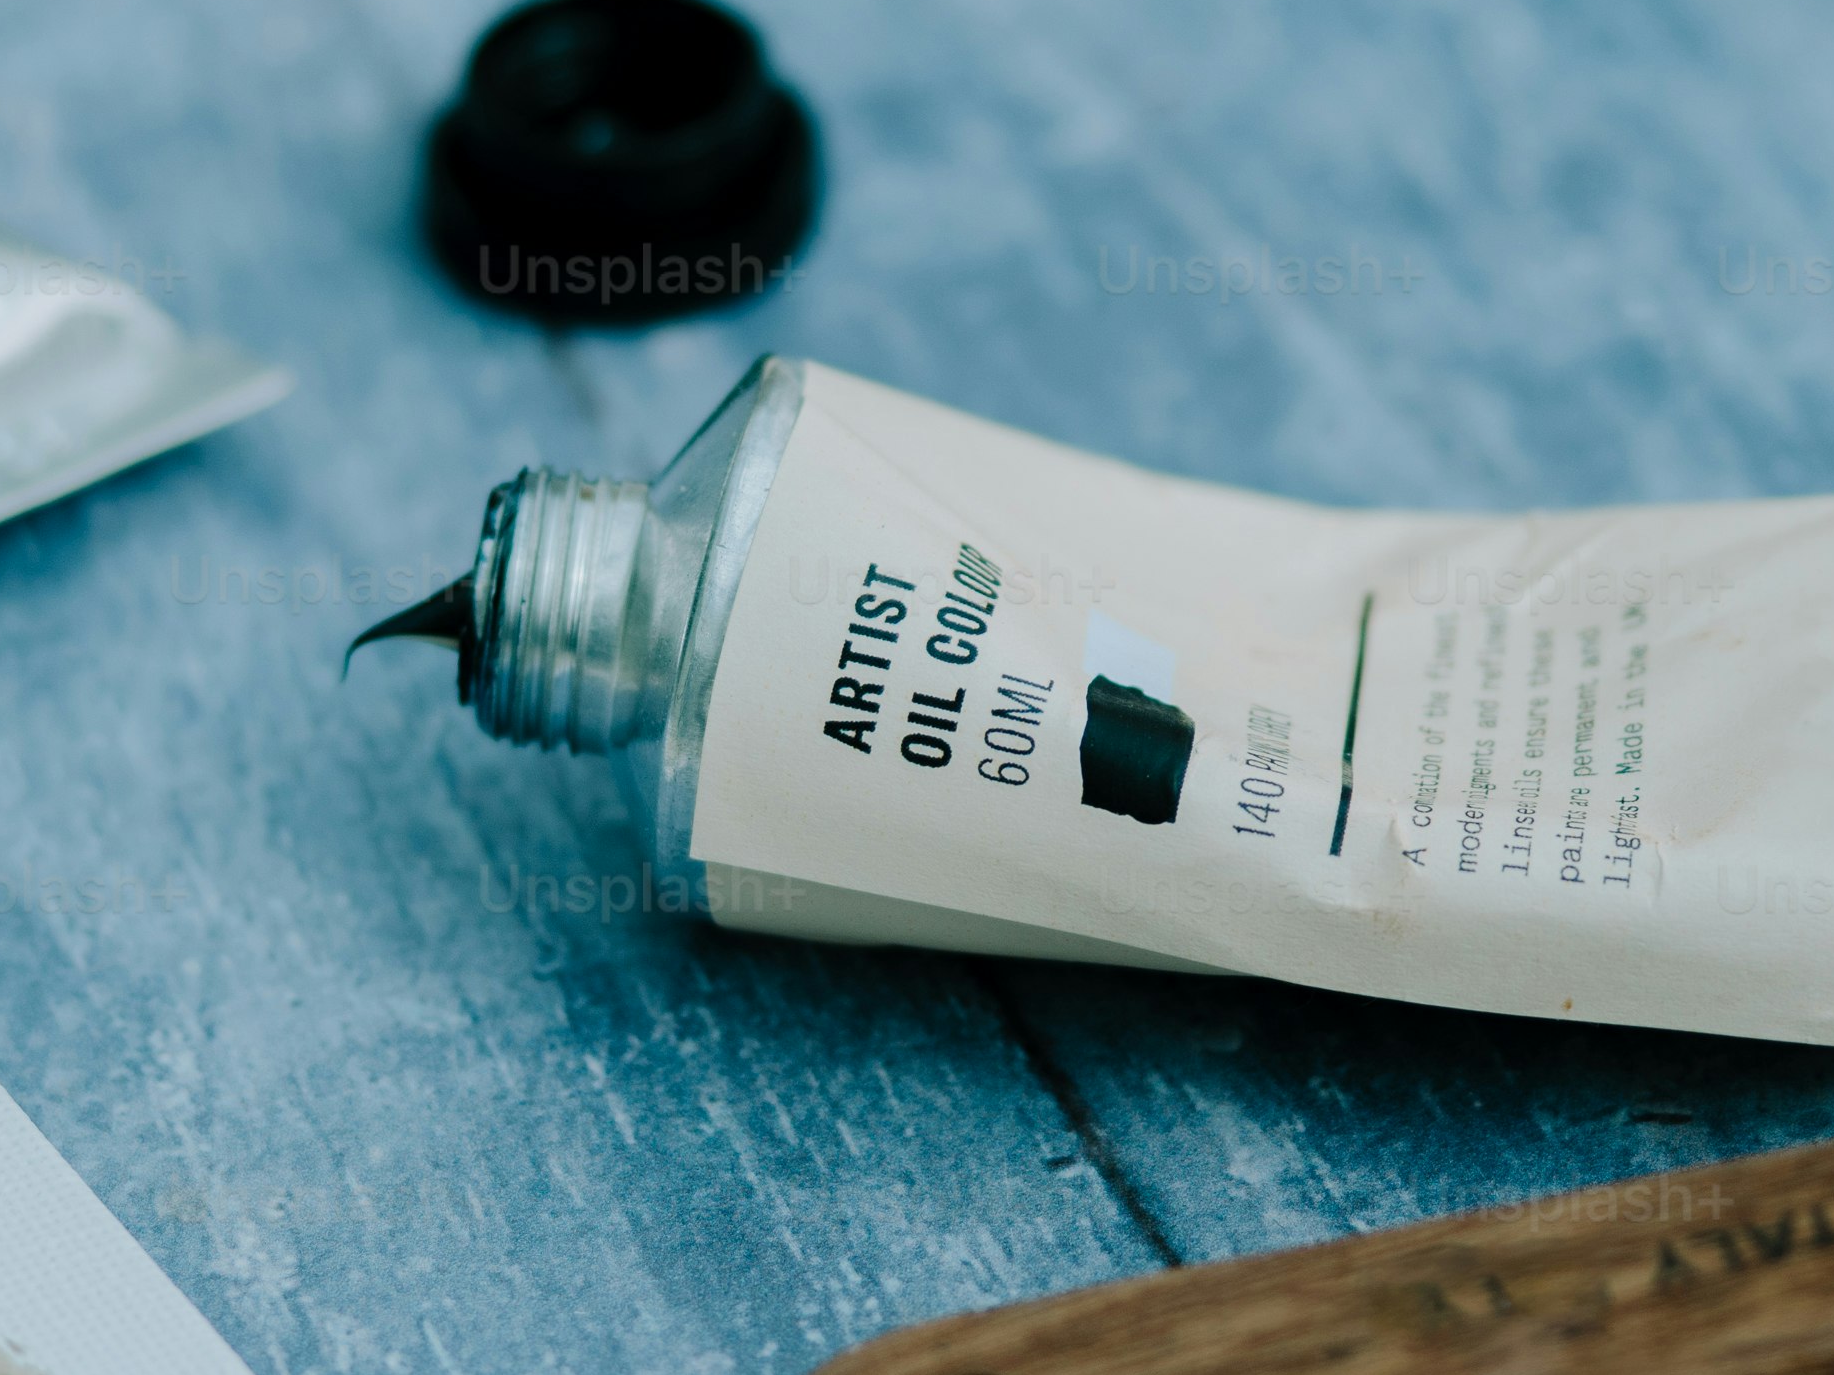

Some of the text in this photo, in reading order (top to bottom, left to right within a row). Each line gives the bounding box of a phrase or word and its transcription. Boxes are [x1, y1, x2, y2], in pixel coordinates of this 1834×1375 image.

[823, 562, 916, 755] ARTIST
[900, 541, 1005, 770] OIL COLOUR
[977, 673, 1056, 787] 60ML
[1474, 698, 1499, 729] and
[1523, 696, 1549, 759] ensure
[1616, 687, 1645, 711] in
[1614, 722, 1644, 775] Made
[1231, 777, 1285, 838] 140
[1401, 847, 1427, 868] A
[1419, 726, 1444, 746] of
[1513, 768, 1542, 798] oils
[1568, 786, 1591, 807] are
[1556, 809, 1585, 885] paints
